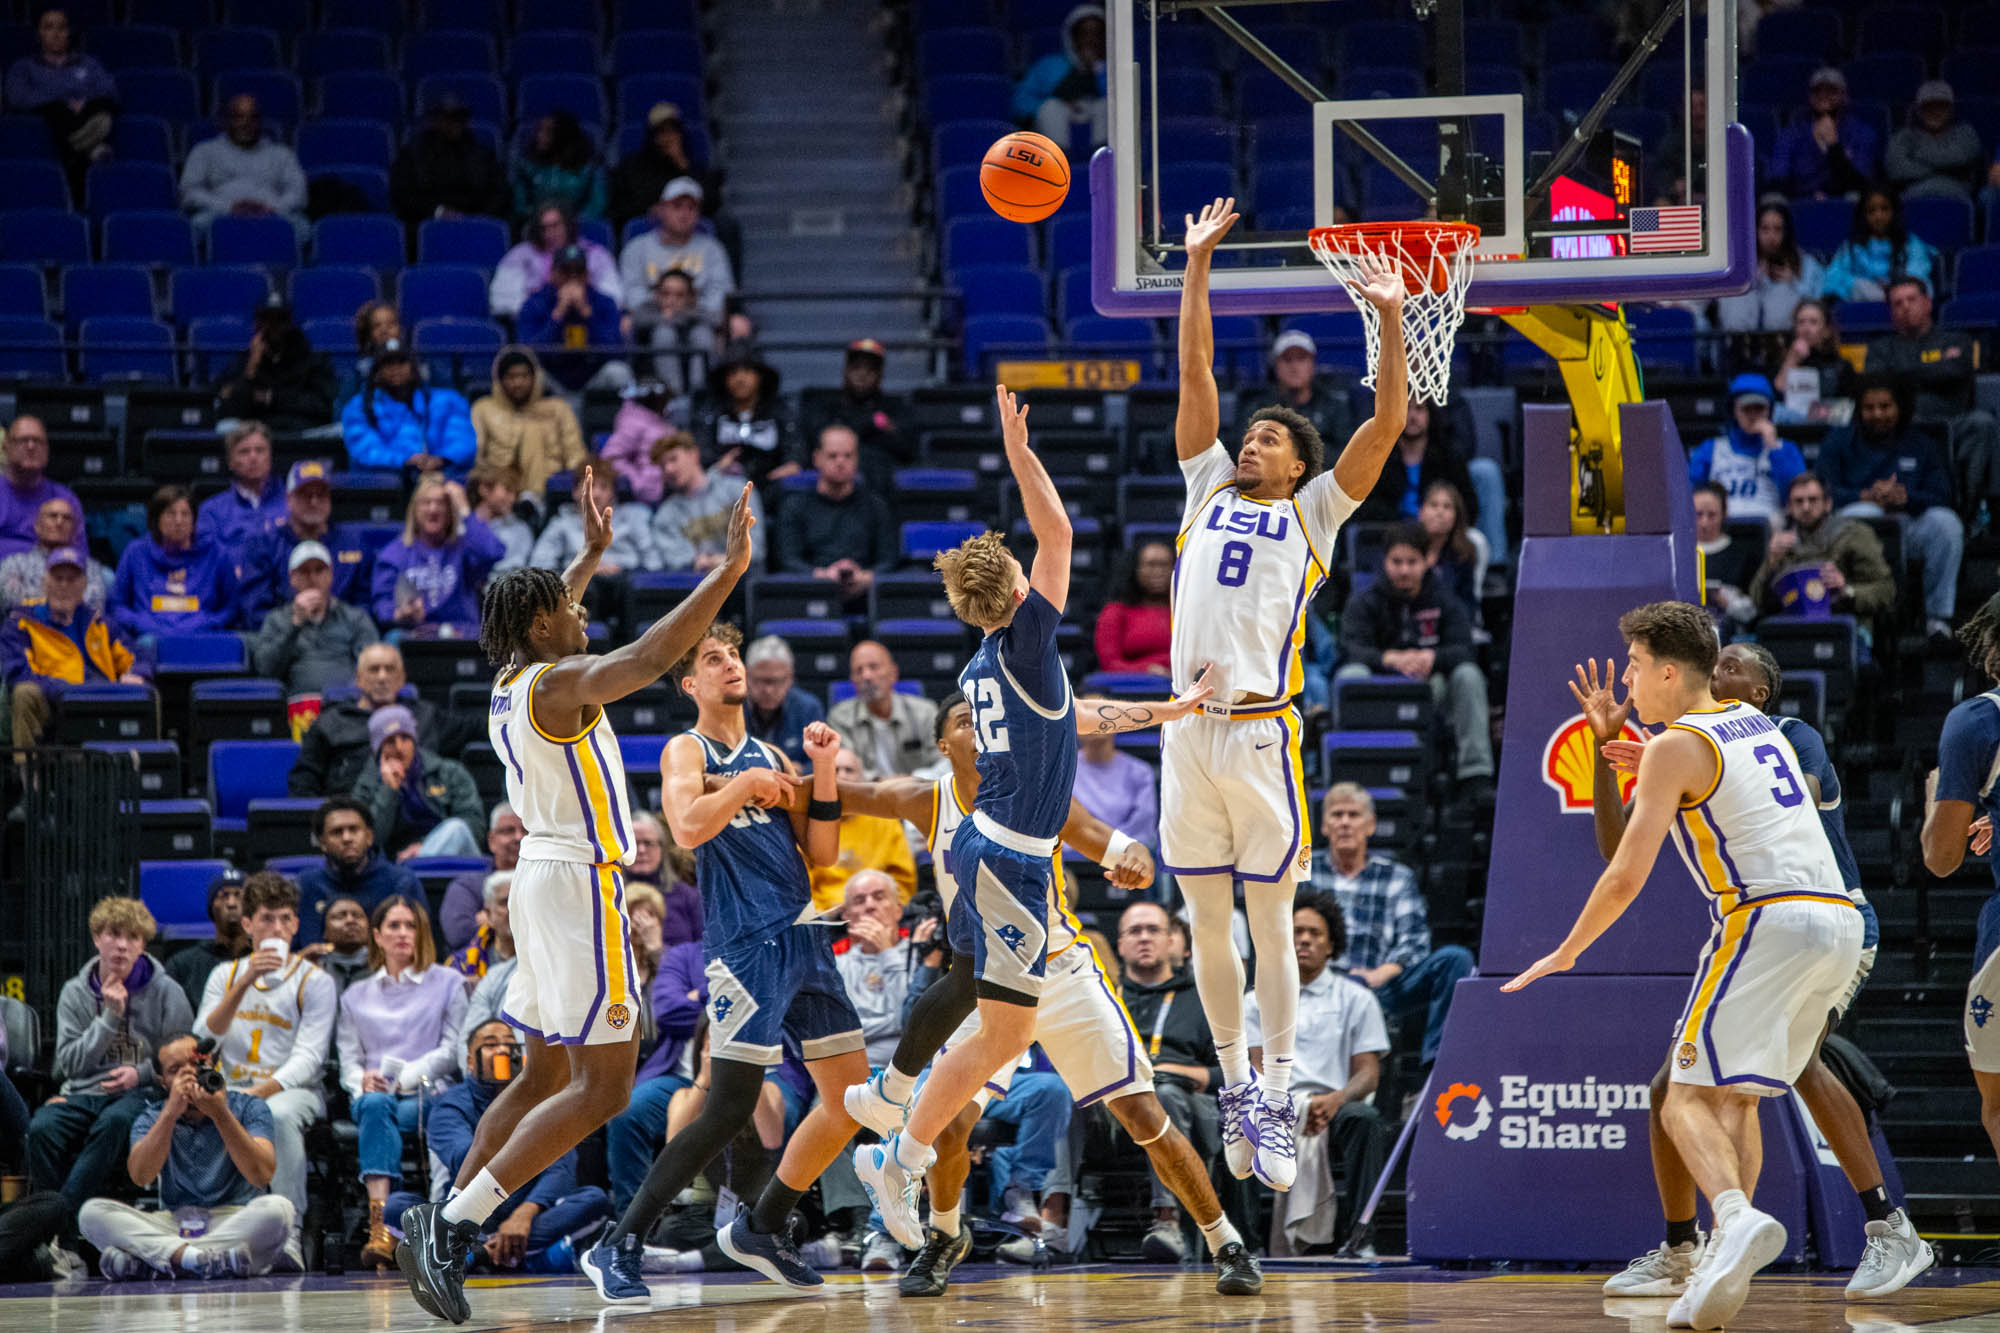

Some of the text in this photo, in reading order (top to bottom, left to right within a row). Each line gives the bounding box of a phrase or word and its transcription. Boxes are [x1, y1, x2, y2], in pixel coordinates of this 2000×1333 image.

[1006, 147, 1043, 167] LSU
[1135, 277, 1184, 291] SPALDIN
[1206, 505, 1288, 541] LSU
[1217, 540, 1254, 588] 8
[1206, 705, 1228, 716] LSU
[1753, 744, 1804, 808] 3
[246, 1027, 262, 1064] 1
[1499, 1115, 1627, 1150] Share
